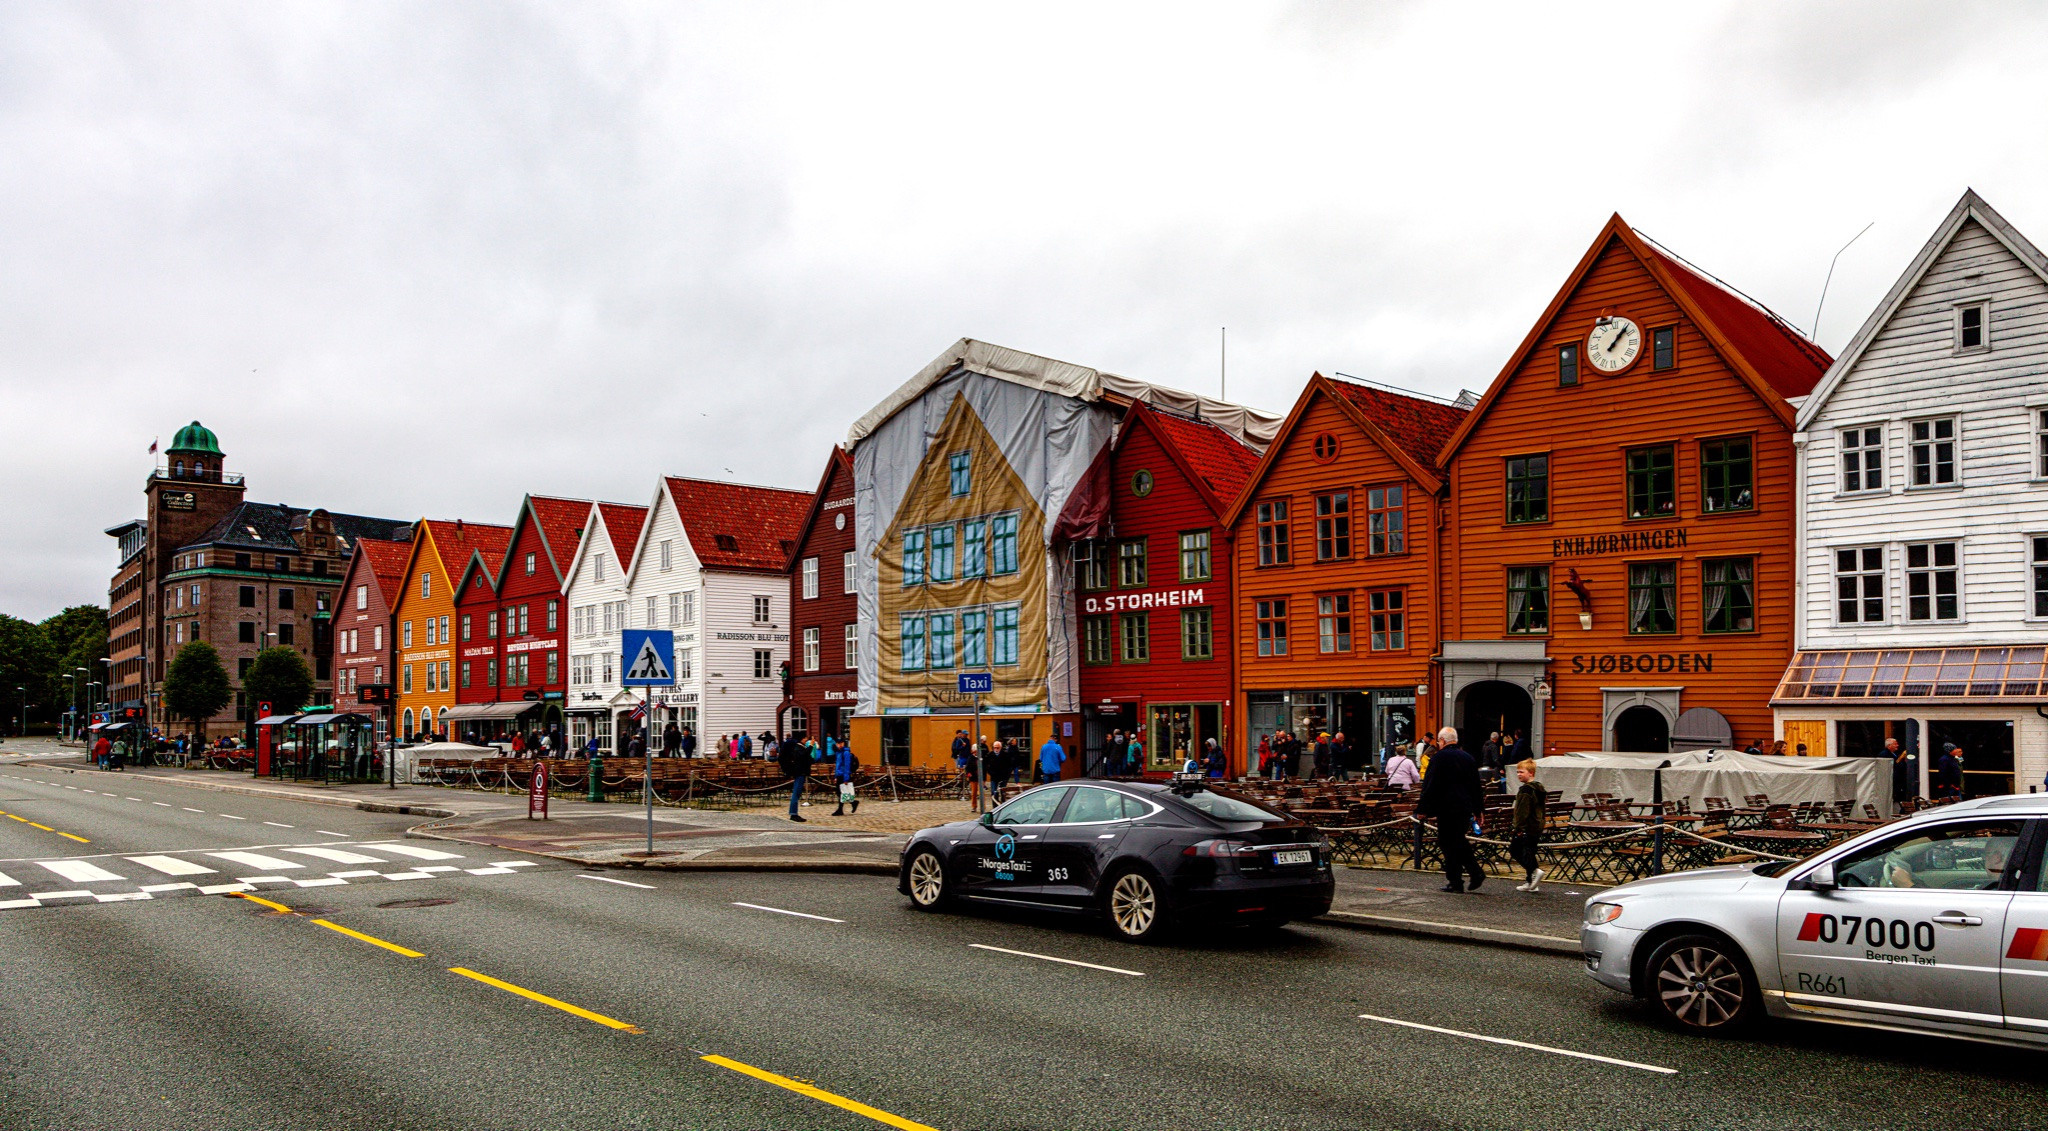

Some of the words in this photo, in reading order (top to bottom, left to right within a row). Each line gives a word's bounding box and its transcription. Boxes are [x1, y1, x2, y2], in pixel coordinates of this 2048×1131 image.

[1553, 528, 1687, 558] ENHJØRNINGEN
[1086, 598, 1102, 613] O.
[1105, 588, 1204, 611] STORHEIM
[717, 632, 755, 641] RADISSON
[758, 633, 771, 641] BLU
[403, 652, 425, 662] RADISSON
[425, 651, 435, 660] BLU
[435, 649, 450, 659] HOTEL
[1572, 653, 1713, 674] SJØBODEN
[963, 677, 988, 689] Taxi
[672, 693, 699, 703] GALLERY
[1279, 853, 1288, 863] EK
[1290, 851, 1309, 862] 12961
[1047, 867, 1069, 881] 363
[1819, 914, 1935, 952] 07000
[1866, 949, 1908, 965] Bergen
[1911, 953, 1936, 967] Taxi
[1798, 972, 1847, 996] R661
